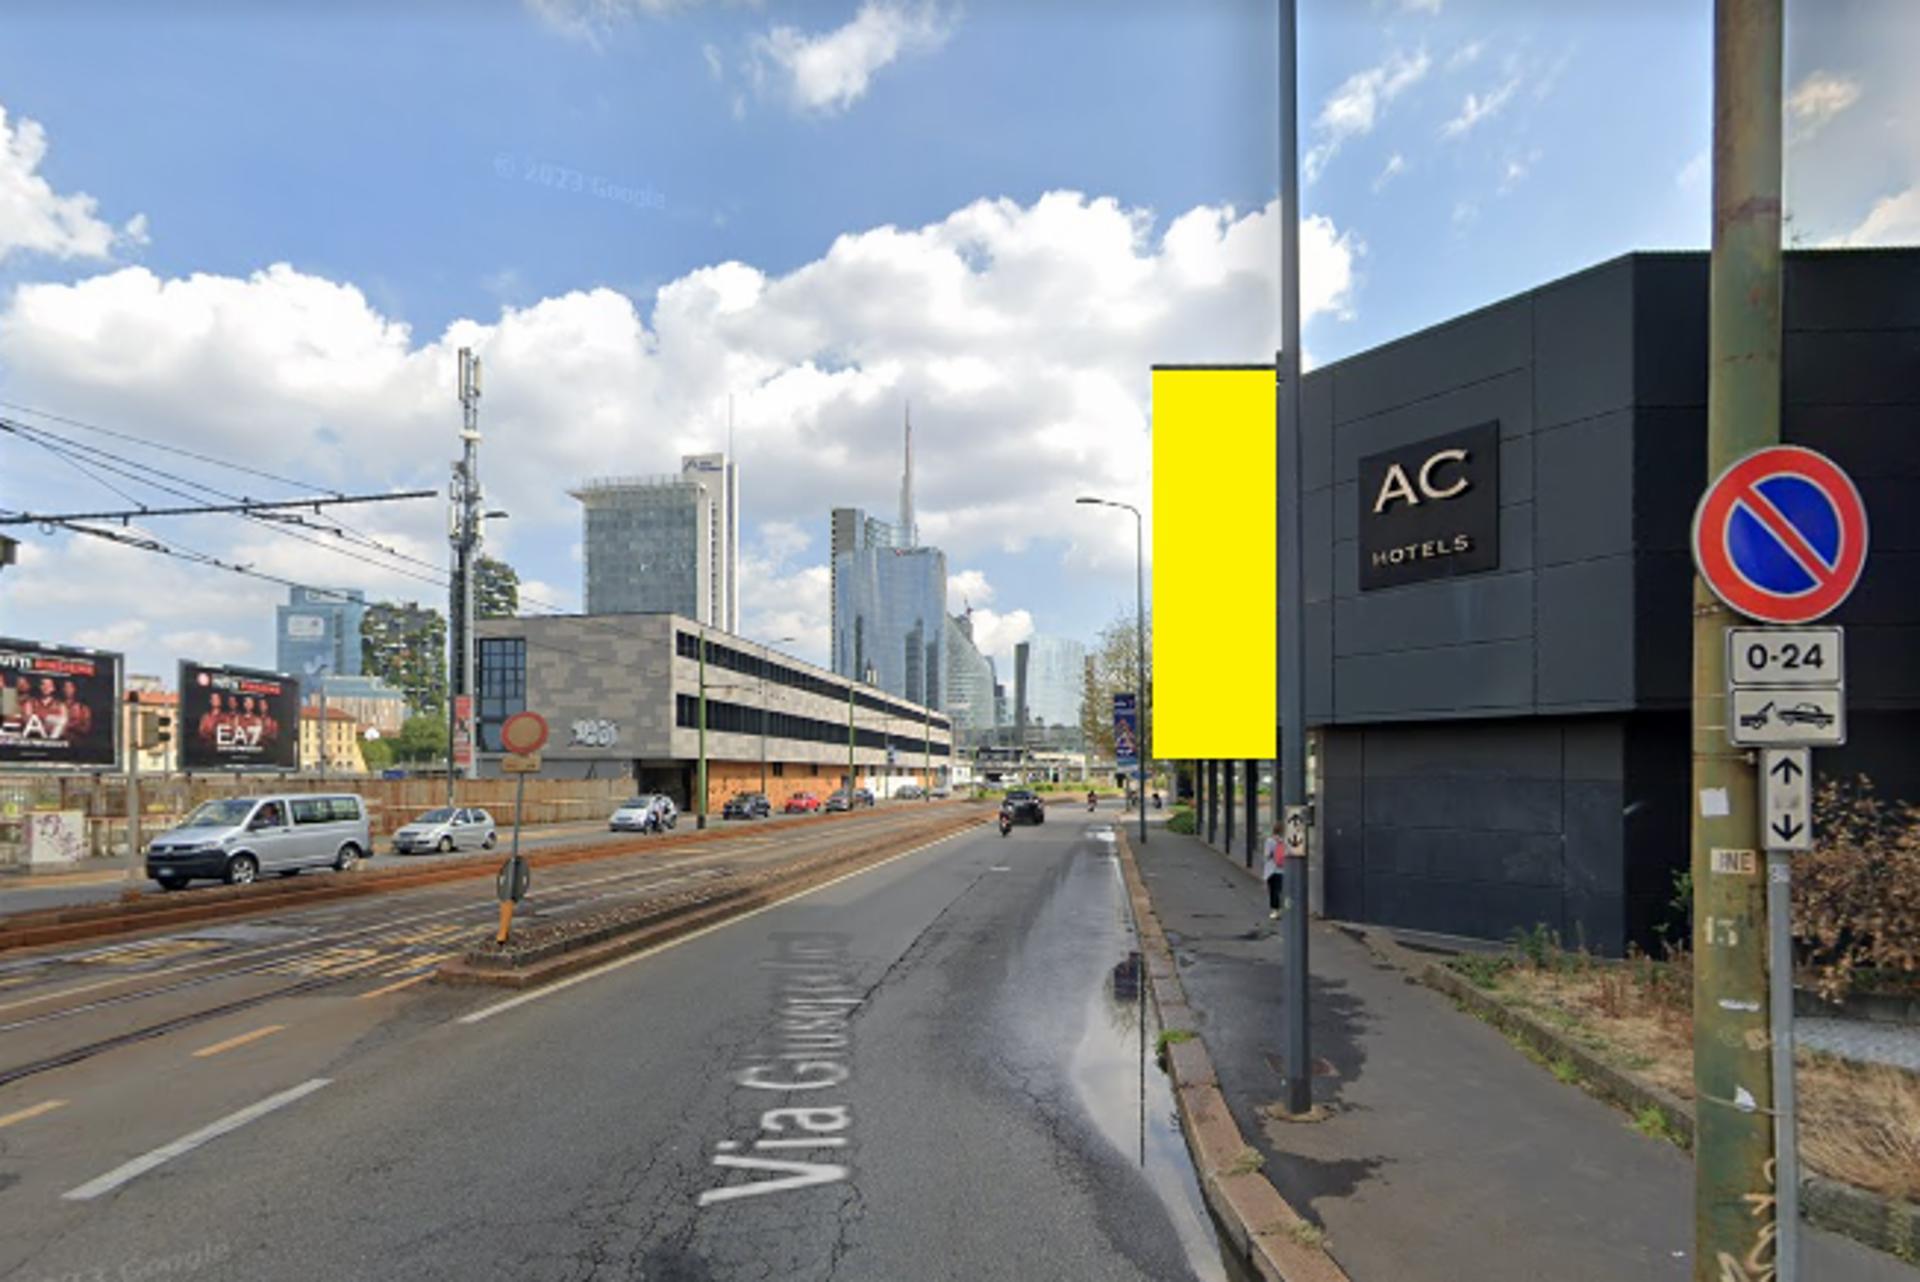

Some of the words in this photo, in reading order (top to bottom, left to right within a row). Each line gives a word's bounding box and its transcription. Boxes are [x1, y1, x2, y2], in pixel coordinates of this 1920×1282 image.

[1372, 449, 1469, 513] AC
[1371, 534, 1470, 569] HOTELS
[1746, 643, 1826, 671] 0-24
[216, 723, 263, 746] EA7
